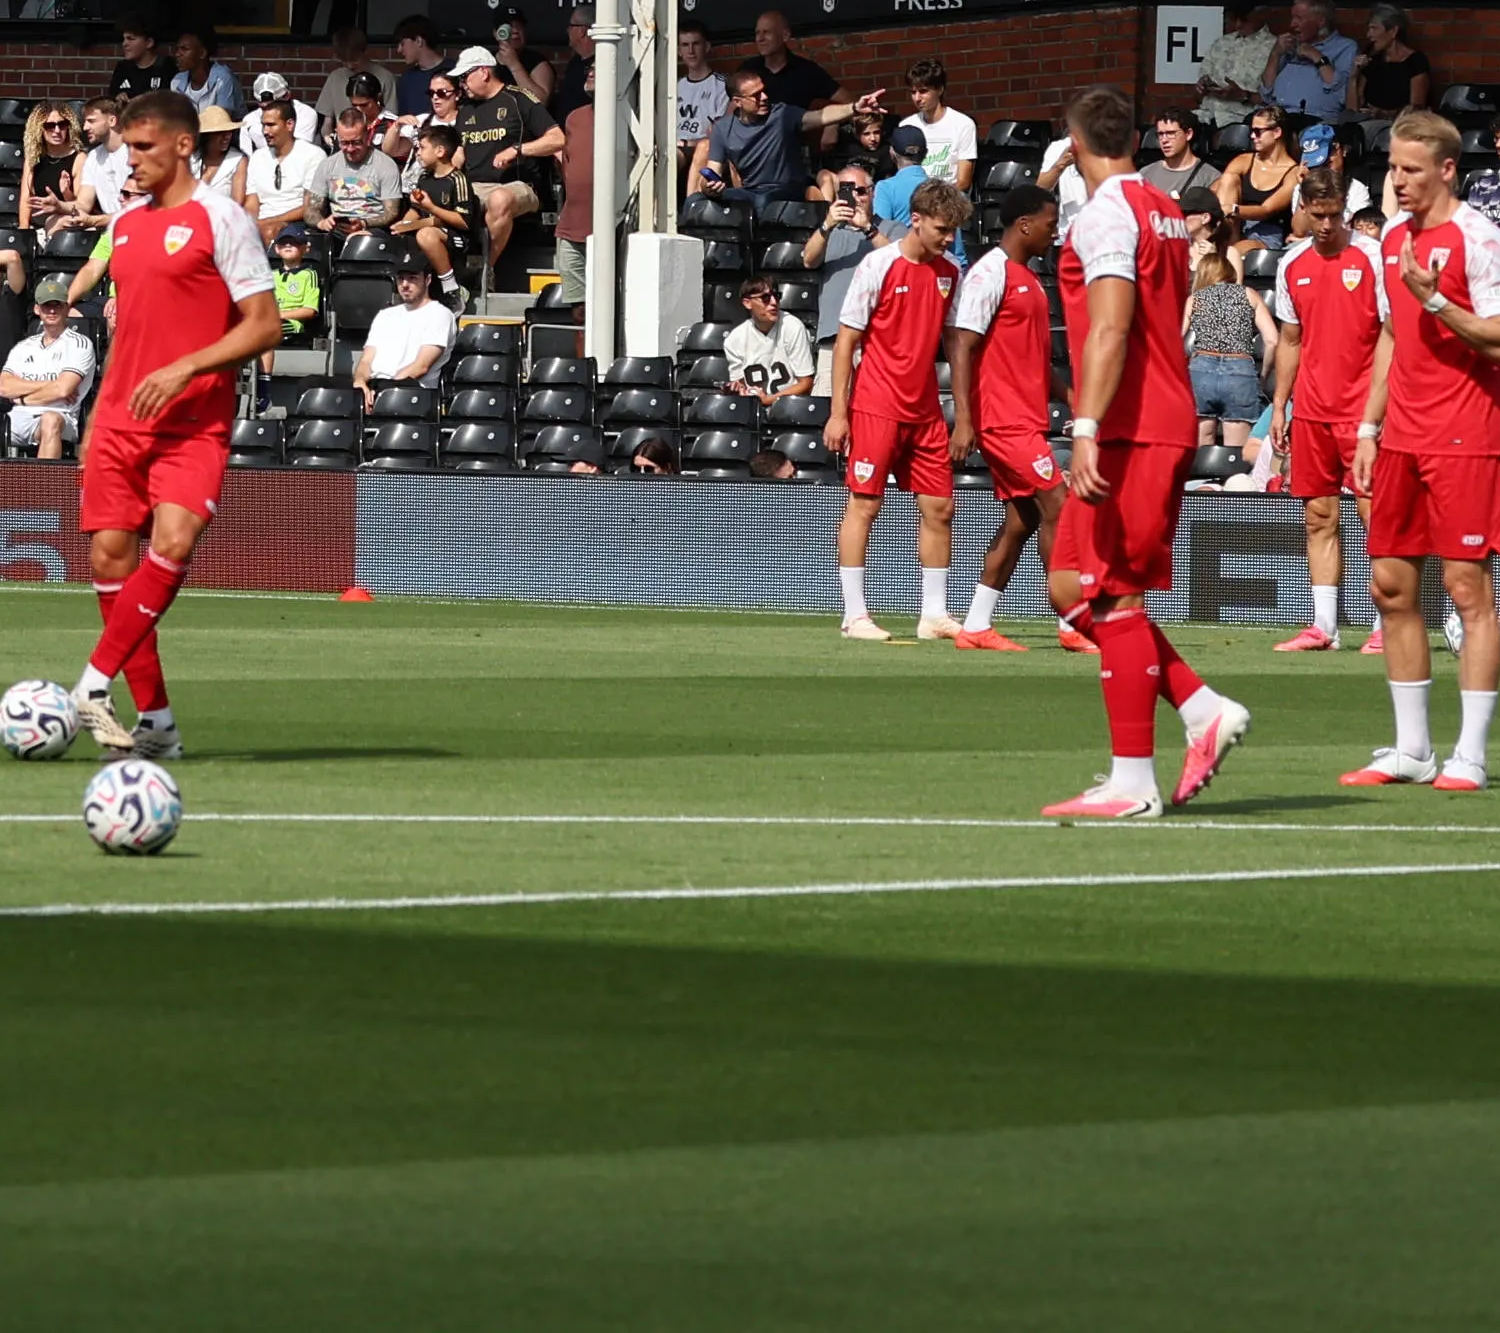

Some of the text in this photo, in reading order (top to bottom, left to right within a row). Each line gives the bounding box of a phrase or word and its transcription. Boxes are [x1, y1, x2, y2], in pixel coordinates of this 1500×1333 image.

[1166, 26, 1204, 63] FL
[468, 128, 507, 144] SBOTOP
[679, 120, 700, 134] 88
[743, 361, 791, 395] 92
